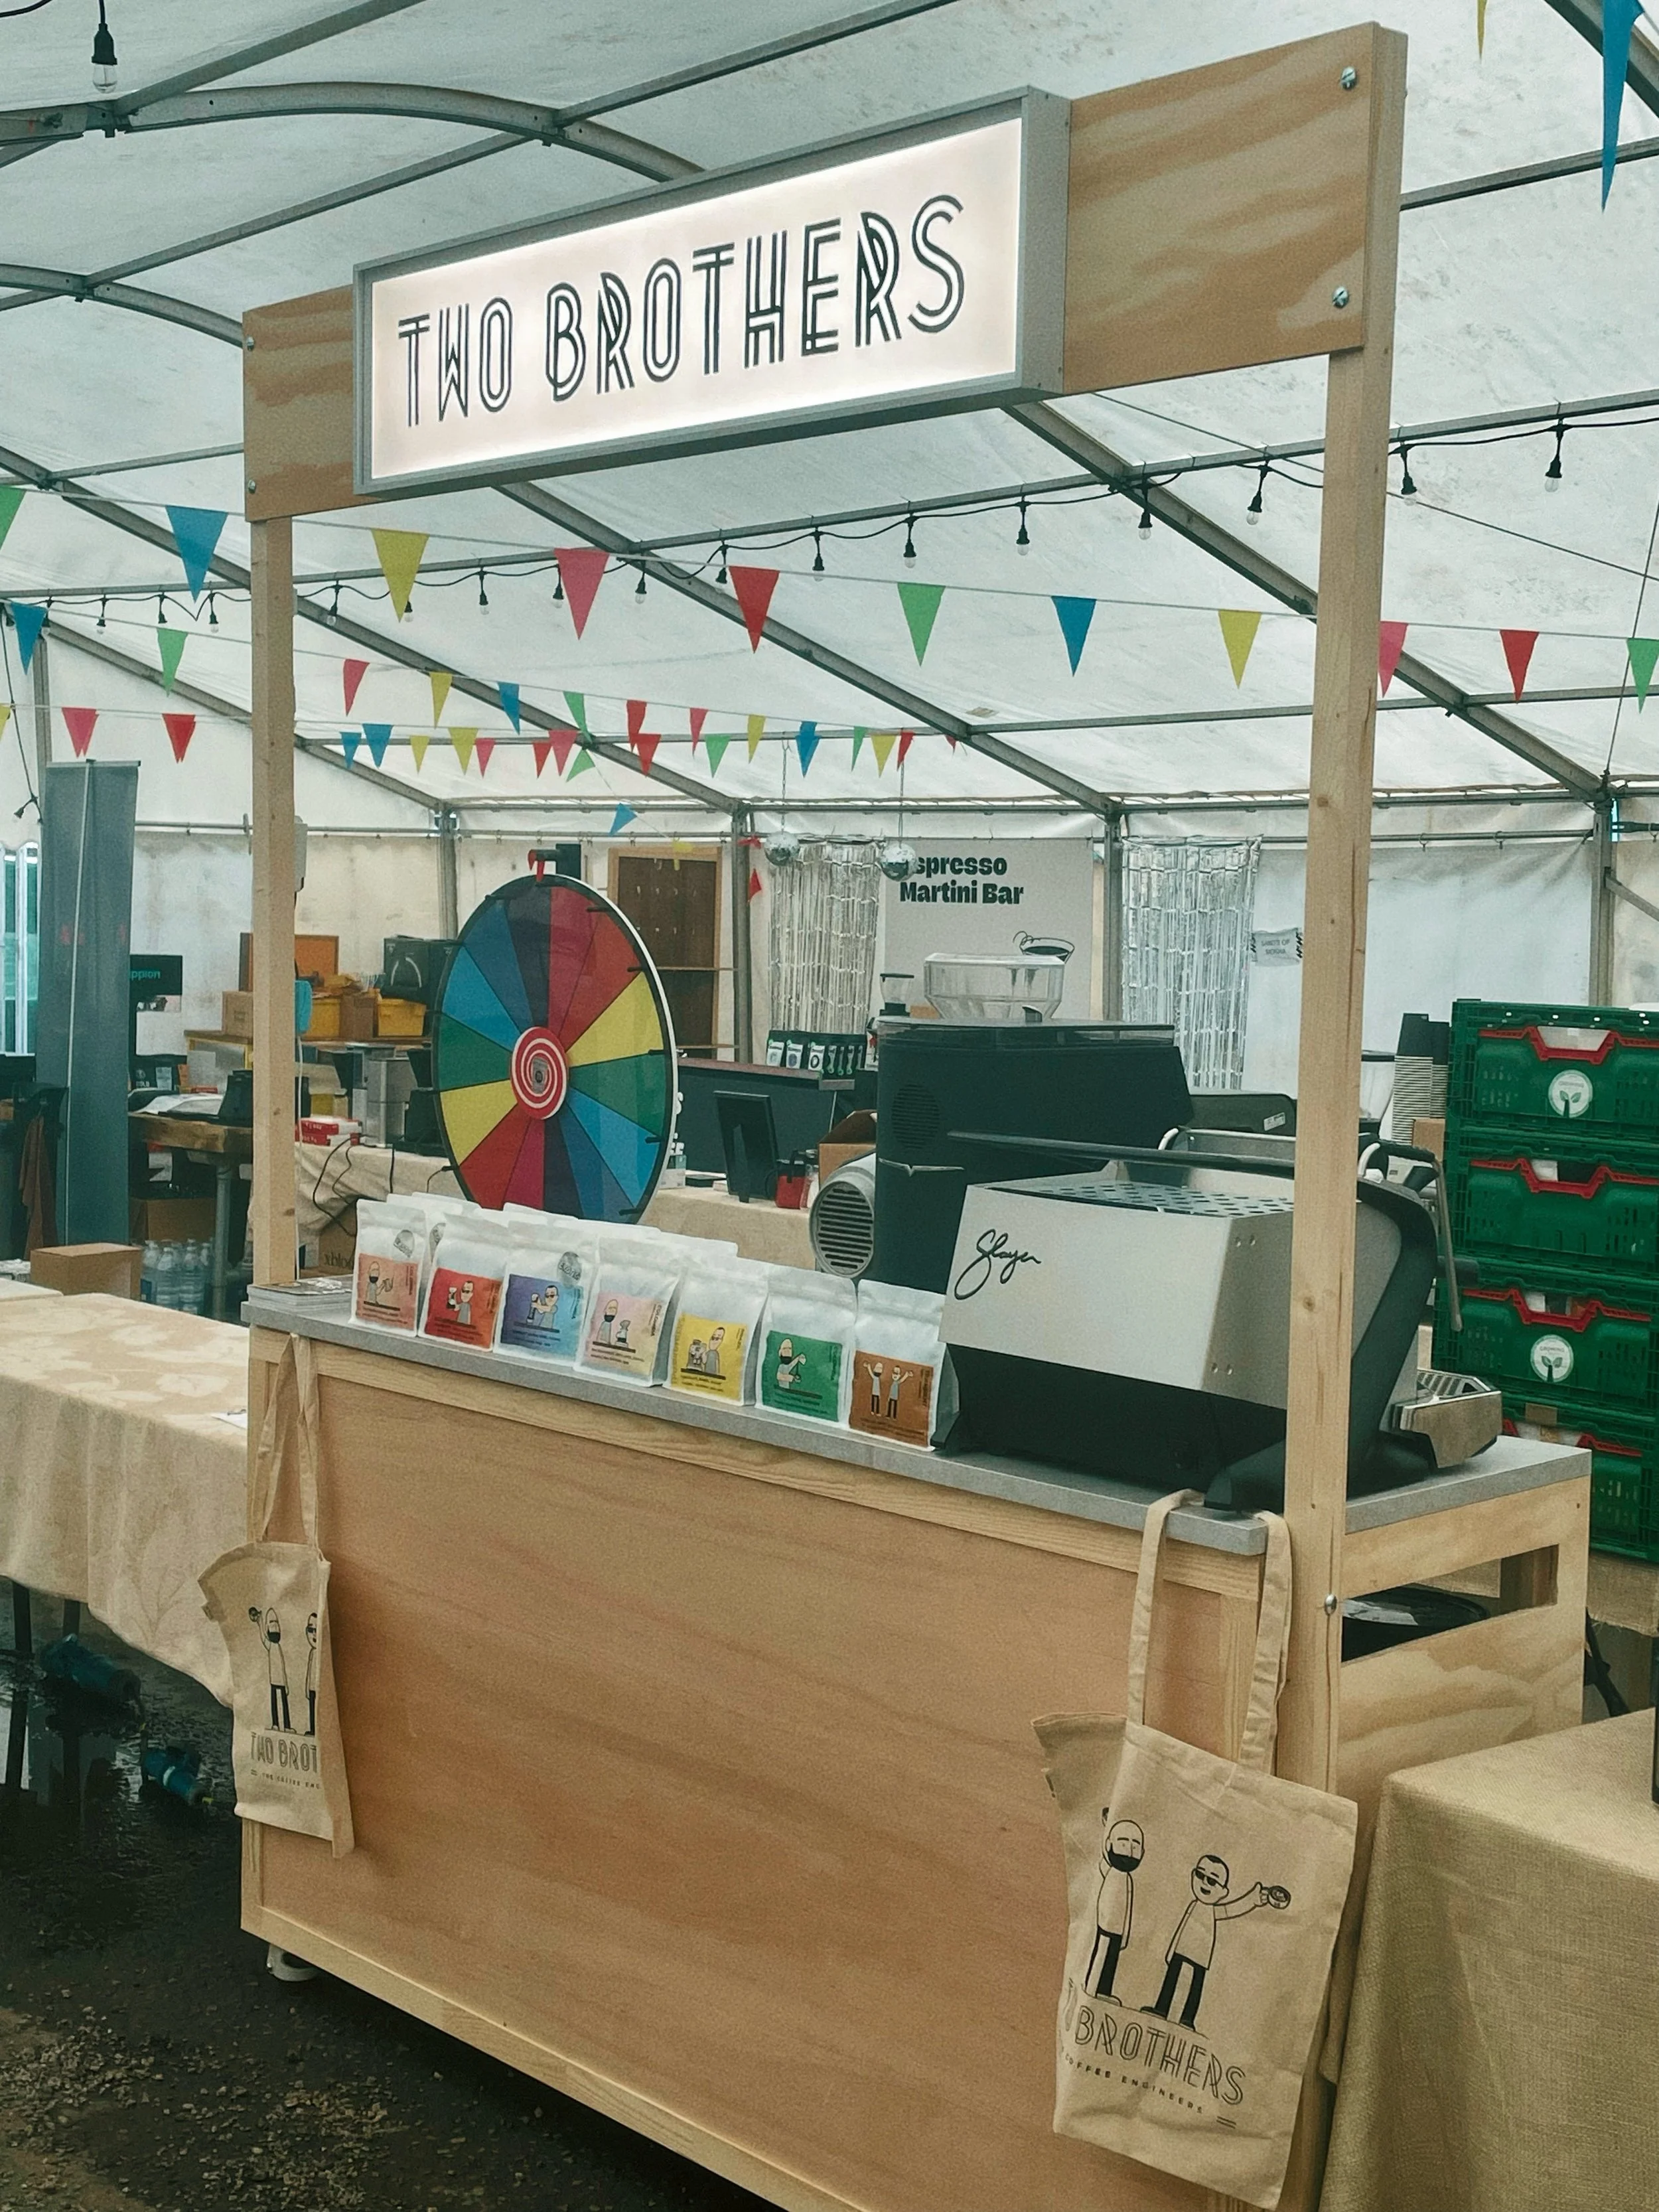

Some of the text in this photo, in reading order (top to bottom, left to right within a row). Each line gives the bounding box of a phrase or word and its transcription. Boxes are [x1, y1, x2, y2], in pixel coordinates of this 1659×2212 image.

[398, 194, 965, 427] TWO BROTHERS
[914, 856, 1007, 879] spresso
[899, 879, 1024, 905] Martini Bar
[251, 1731, 273, 1765] TWO
[1074, 2004, 1246, 2106] BROTHERS
[1121, 2075, 1203, 2114] ENGINEERS
